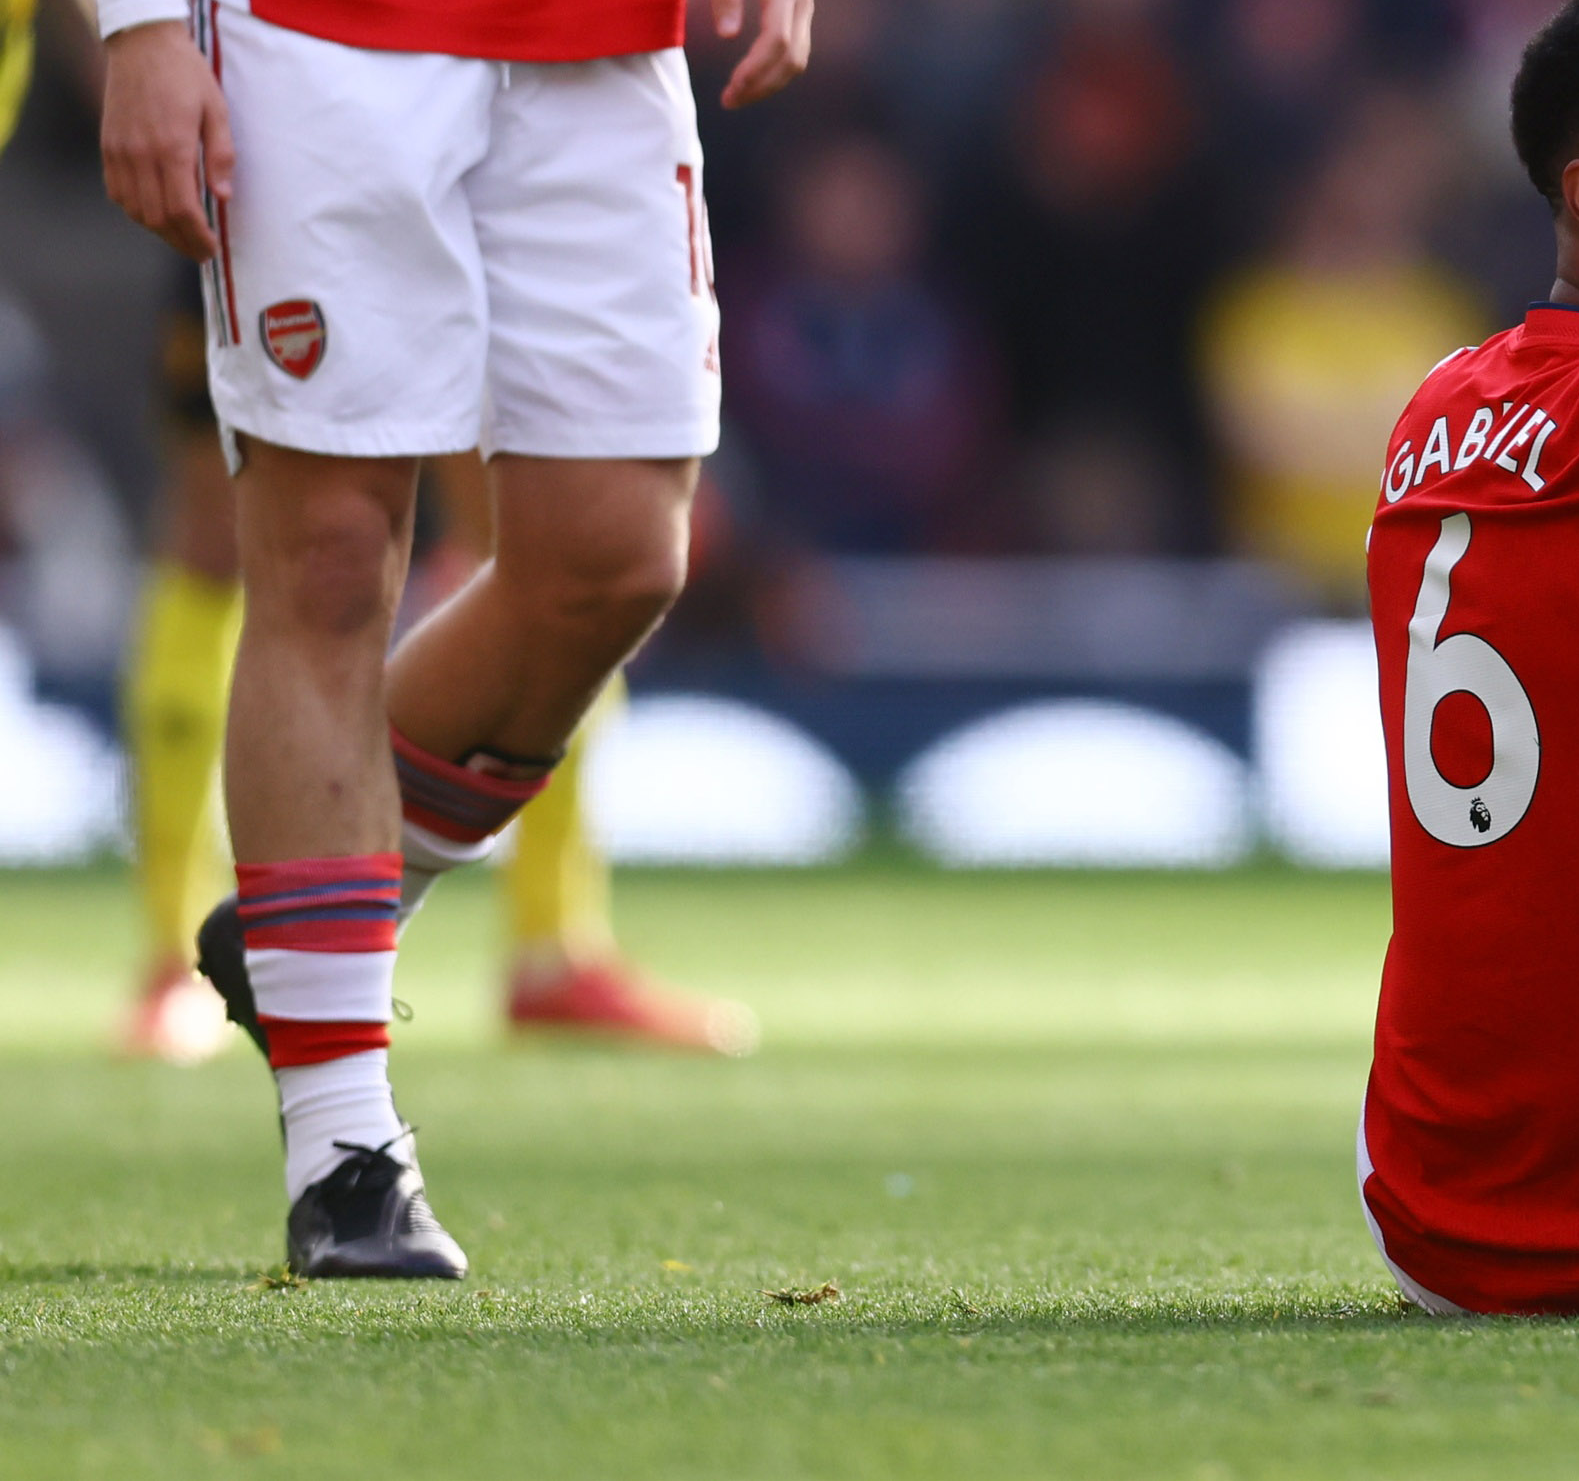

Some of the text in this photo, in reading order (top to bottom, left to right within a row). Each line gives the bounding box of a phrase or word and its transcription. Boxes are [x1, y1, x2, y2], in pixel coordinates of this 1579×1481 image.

[676, 164, 716, 303] 1
[1385, 400, 1558, 504] GABIEL
[1403, 512, 1541, 849] 6
